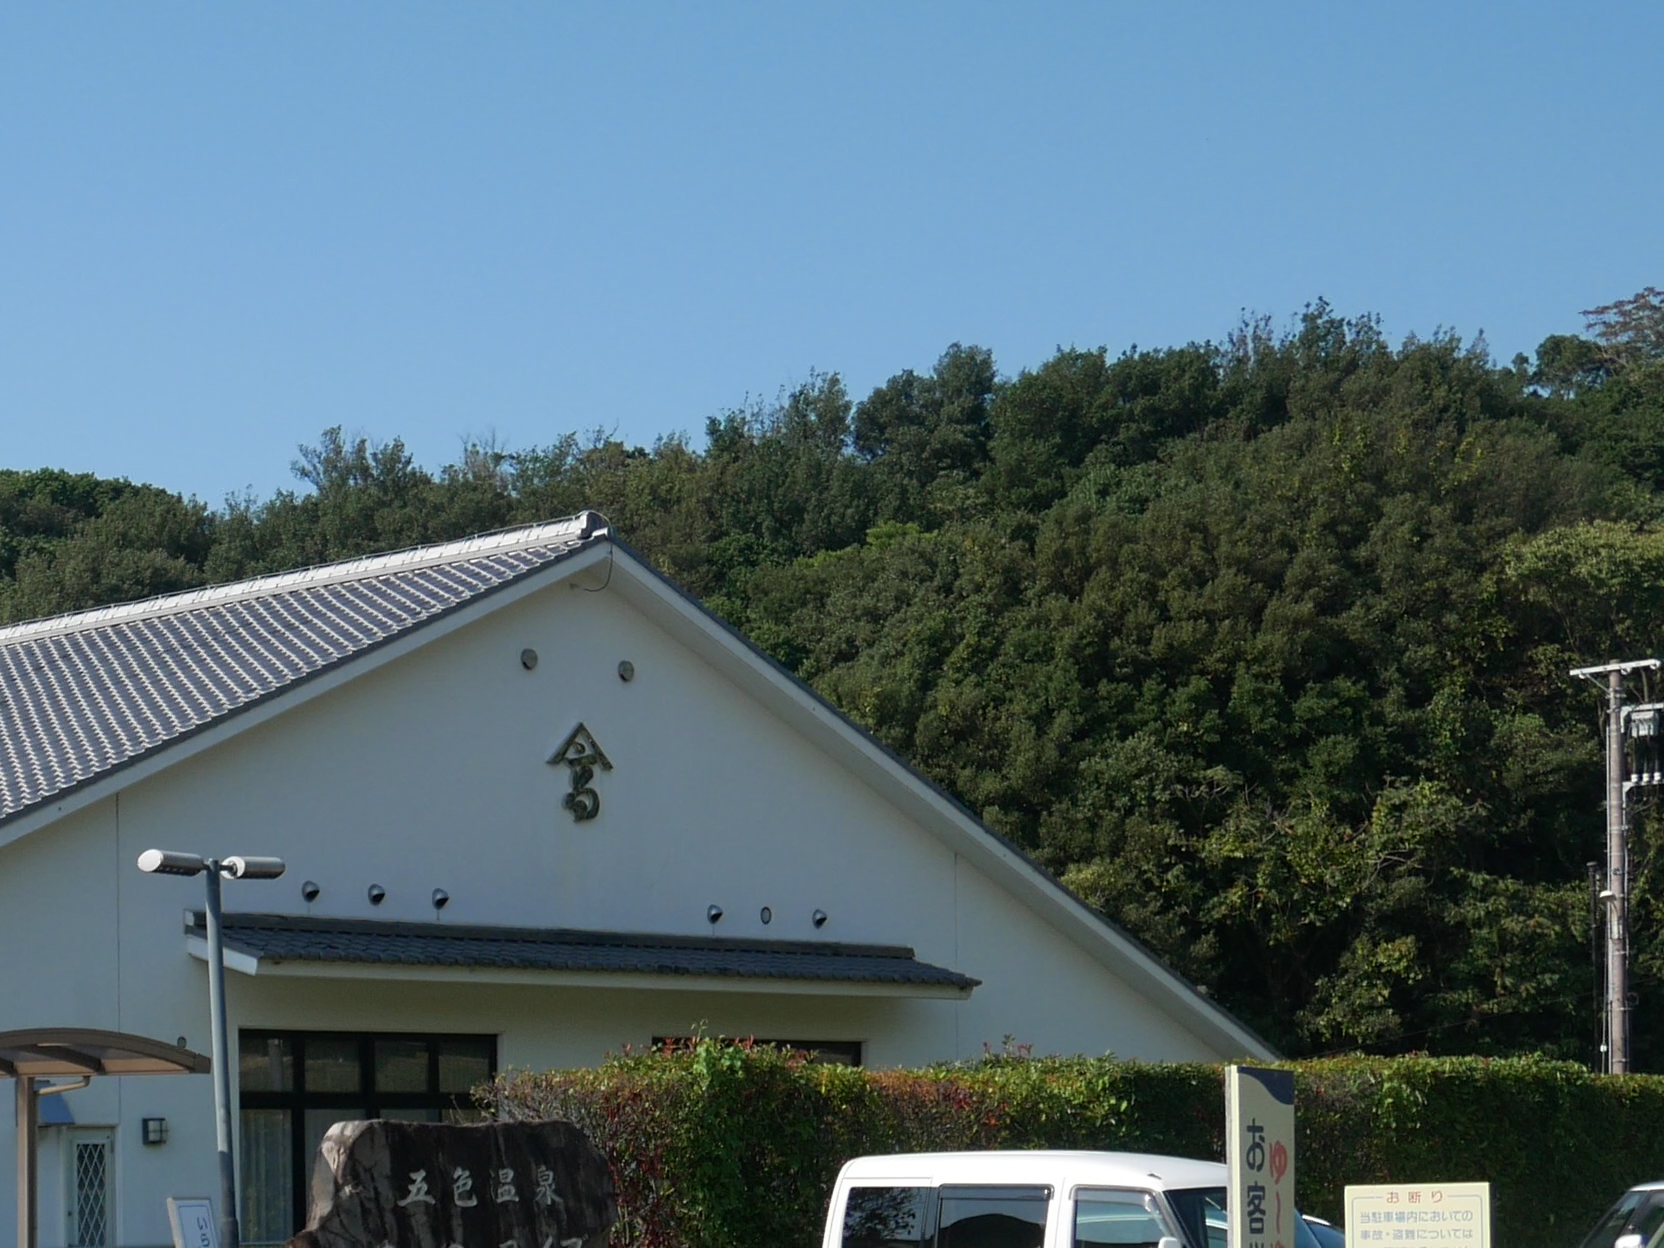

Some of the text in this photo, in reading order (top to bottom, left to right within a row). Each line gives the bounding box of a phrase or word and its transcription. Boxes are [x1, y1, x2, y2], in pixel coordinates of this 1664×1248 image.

[396, 1164, 564, 1208] 五色温泉
[1386, 1189, 1443, 1204] お断り
[1359, 1210, 1474, 1224] 当駐車場内においての
[1359, 1228, 1474, 1241] 事故・盗難については
